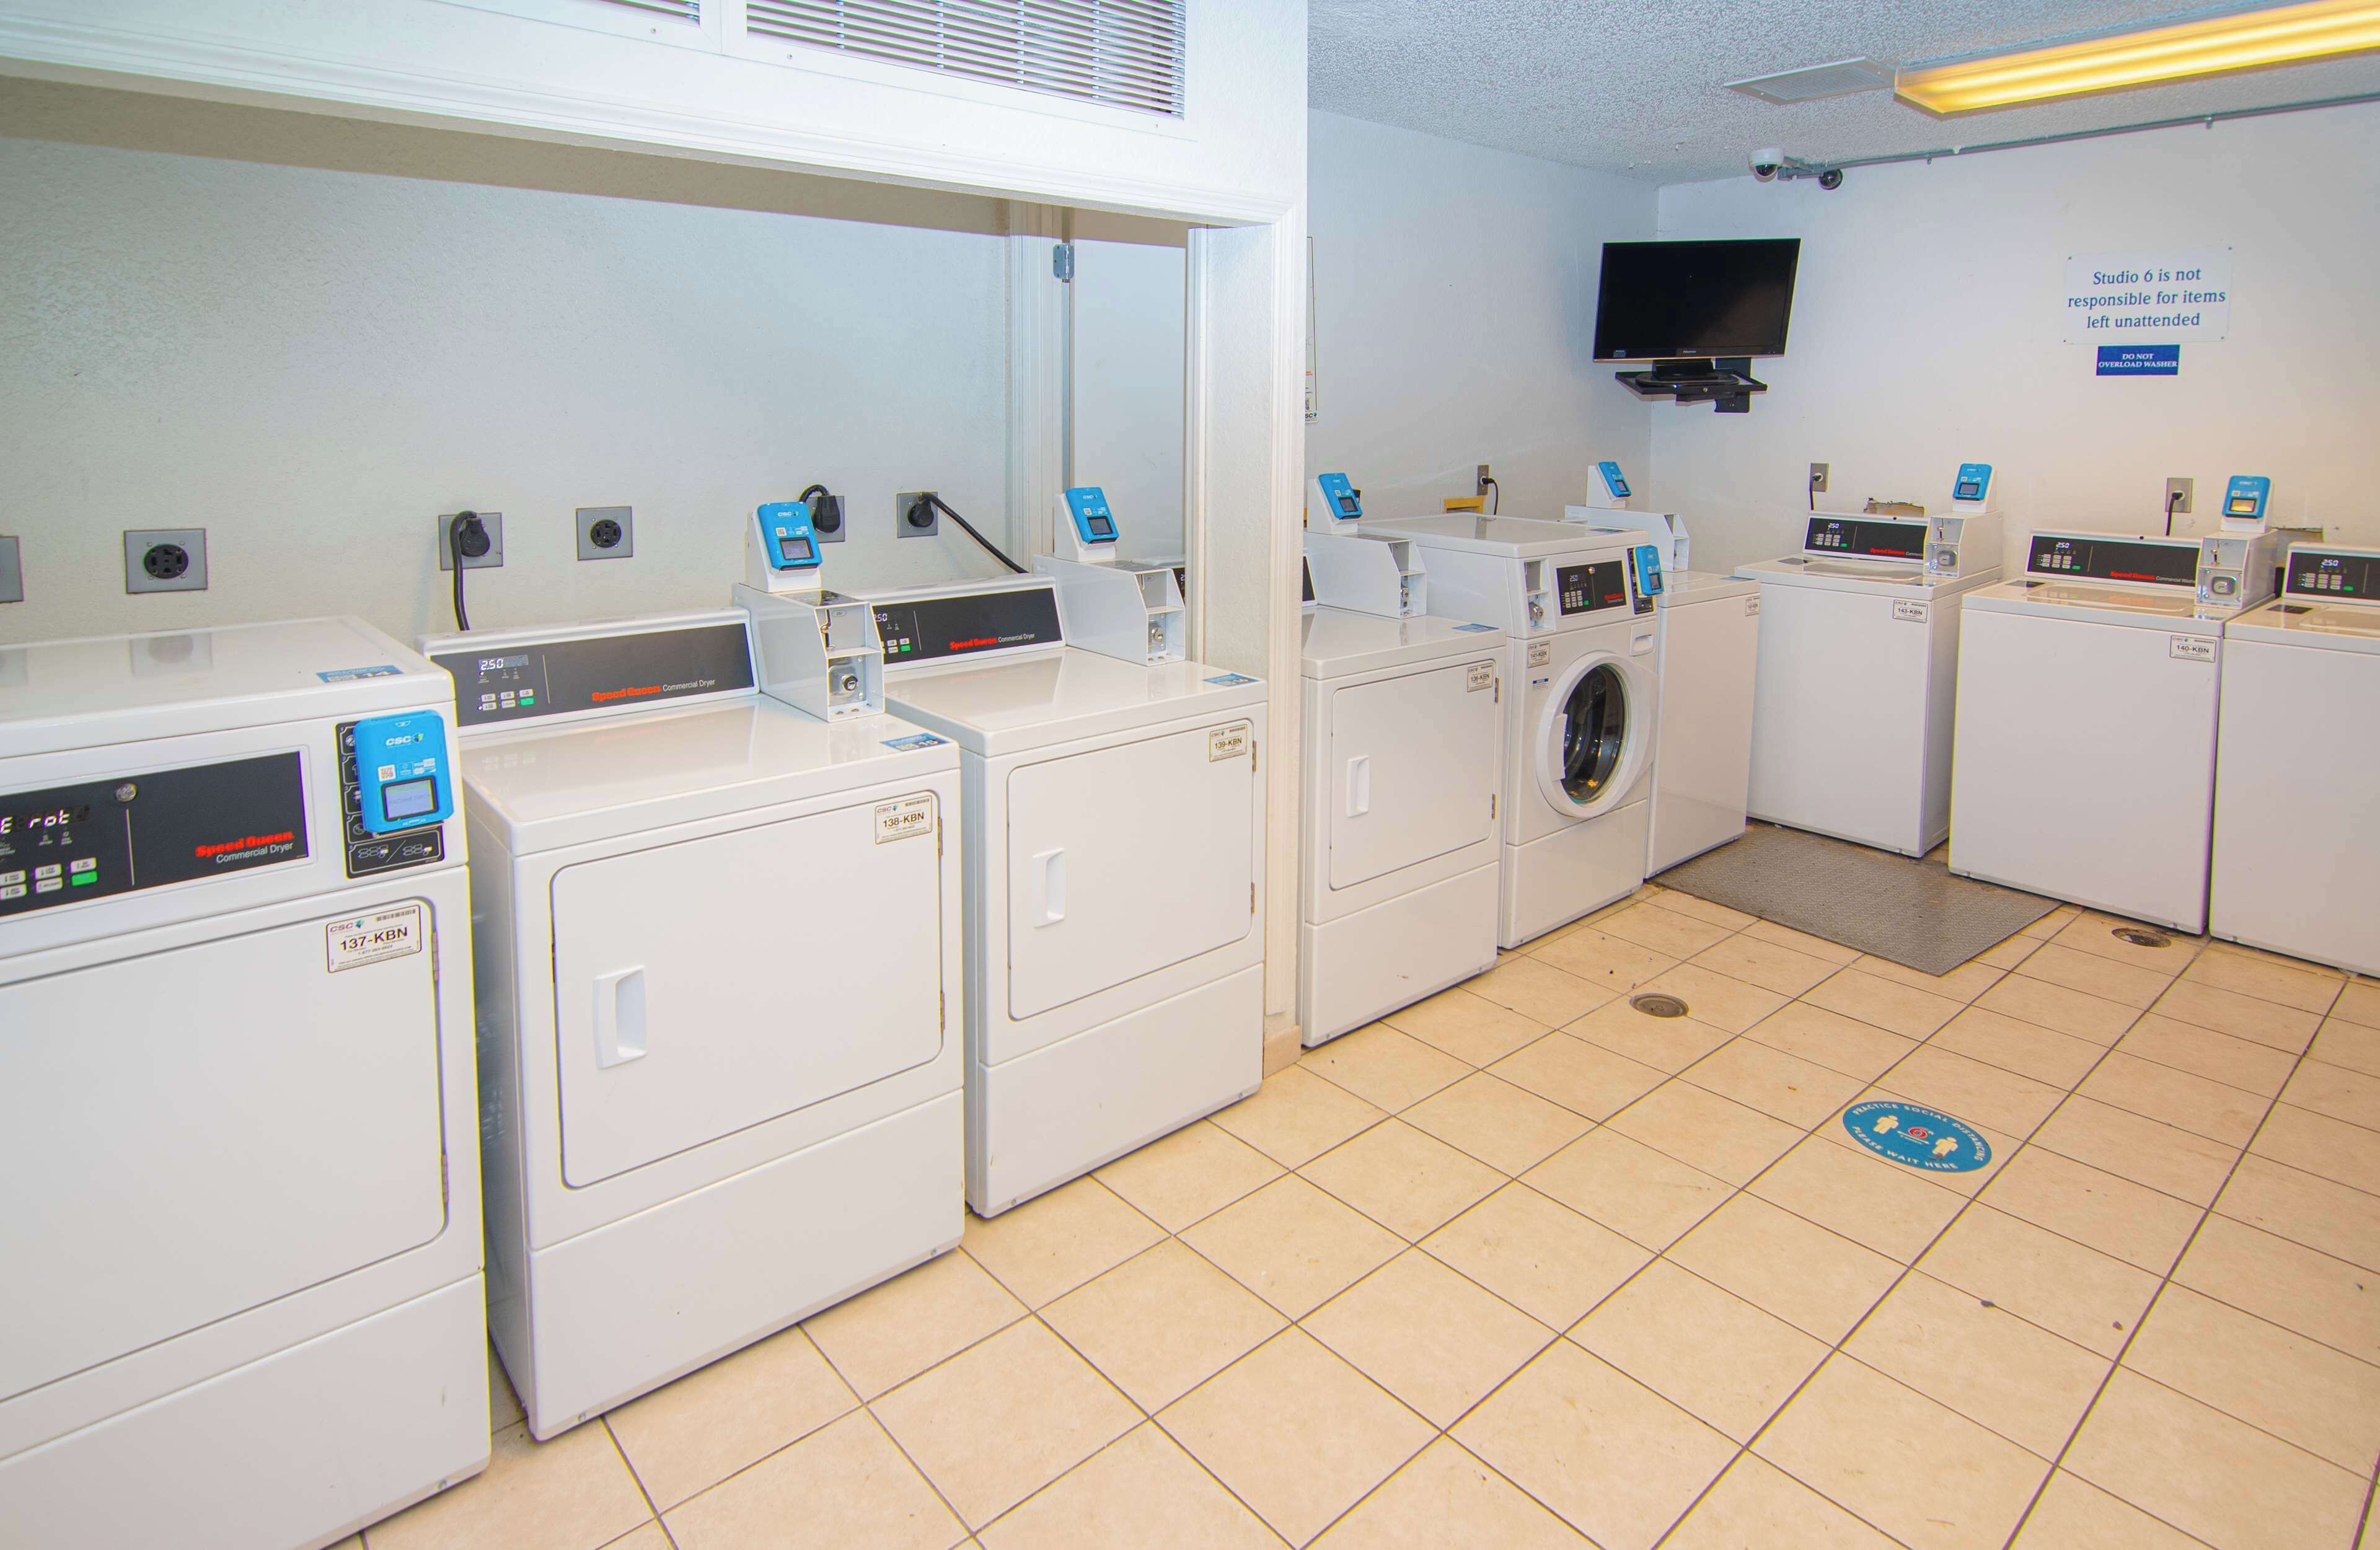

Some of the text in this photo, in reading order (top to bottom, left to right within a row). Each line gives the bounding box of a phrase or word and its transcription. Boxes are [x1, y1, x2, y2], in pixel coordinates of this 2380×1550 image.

[2093, 268, 2202, 285] Studio 6 is not
[2068, 289, 2226, 310] responsible for items
[2087, 312, 2200, 328] left unattended
[949, 641, 973, 650] Speed
[998, 634, 1023, 643] Commercial
[1023, 633, 1035, 641] Dryer
[2177, 645, 2209, 653] 140-KBN
[592, 679, 716, 702] Speed Queen Commercial Dryer
[386, 734, 412, 746] CSC
[1215, 738, 1242, 749] 139-KBN
[883, 812, 925, 828] 138-KBN
[195, 831, 294, 858] Speed Queen
[216, 842, 294, 863] Commercial Dryer
[330, 922, 353, 933] CSC
[340, 927, 408, 951] 137-KBN
[1853, 1103, 1986, 1161] PRACTICE SOCIAL DISTANCING
[1852, 1126, 1884, 1150] PLEASE
[1887, 1150, 1919, 1164] WAIT
[1924, 1161, 1959, 1169] HERE
